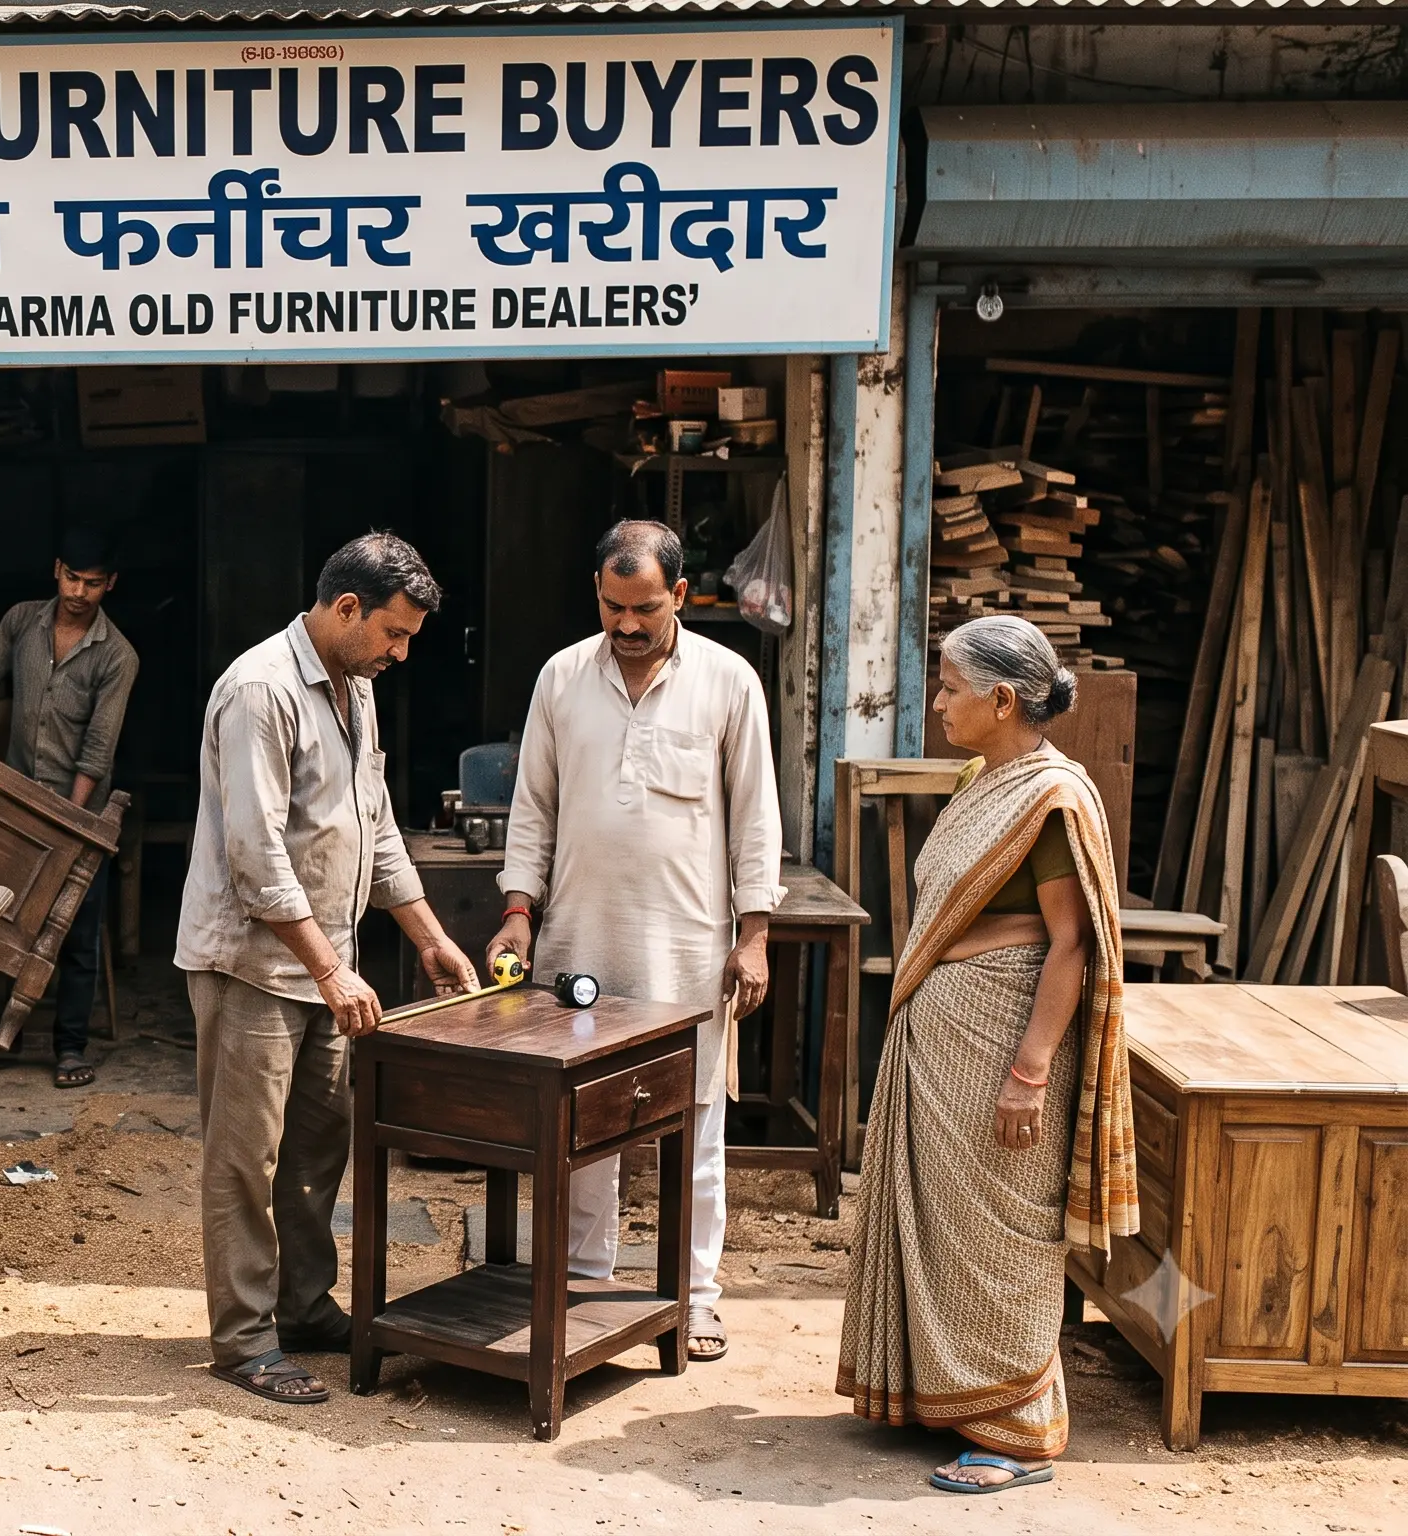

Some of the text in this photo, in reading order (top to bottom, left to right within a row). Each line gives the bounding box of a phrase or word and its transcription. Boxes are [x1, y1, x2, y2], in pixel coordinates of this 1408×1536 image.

[500, 54, 880, 152] BUYERS
[465, 161, 839, 274] खरीदार
[128, 293, 214, 336] OLD
[229, 288, 477, 335] FURNITURE
